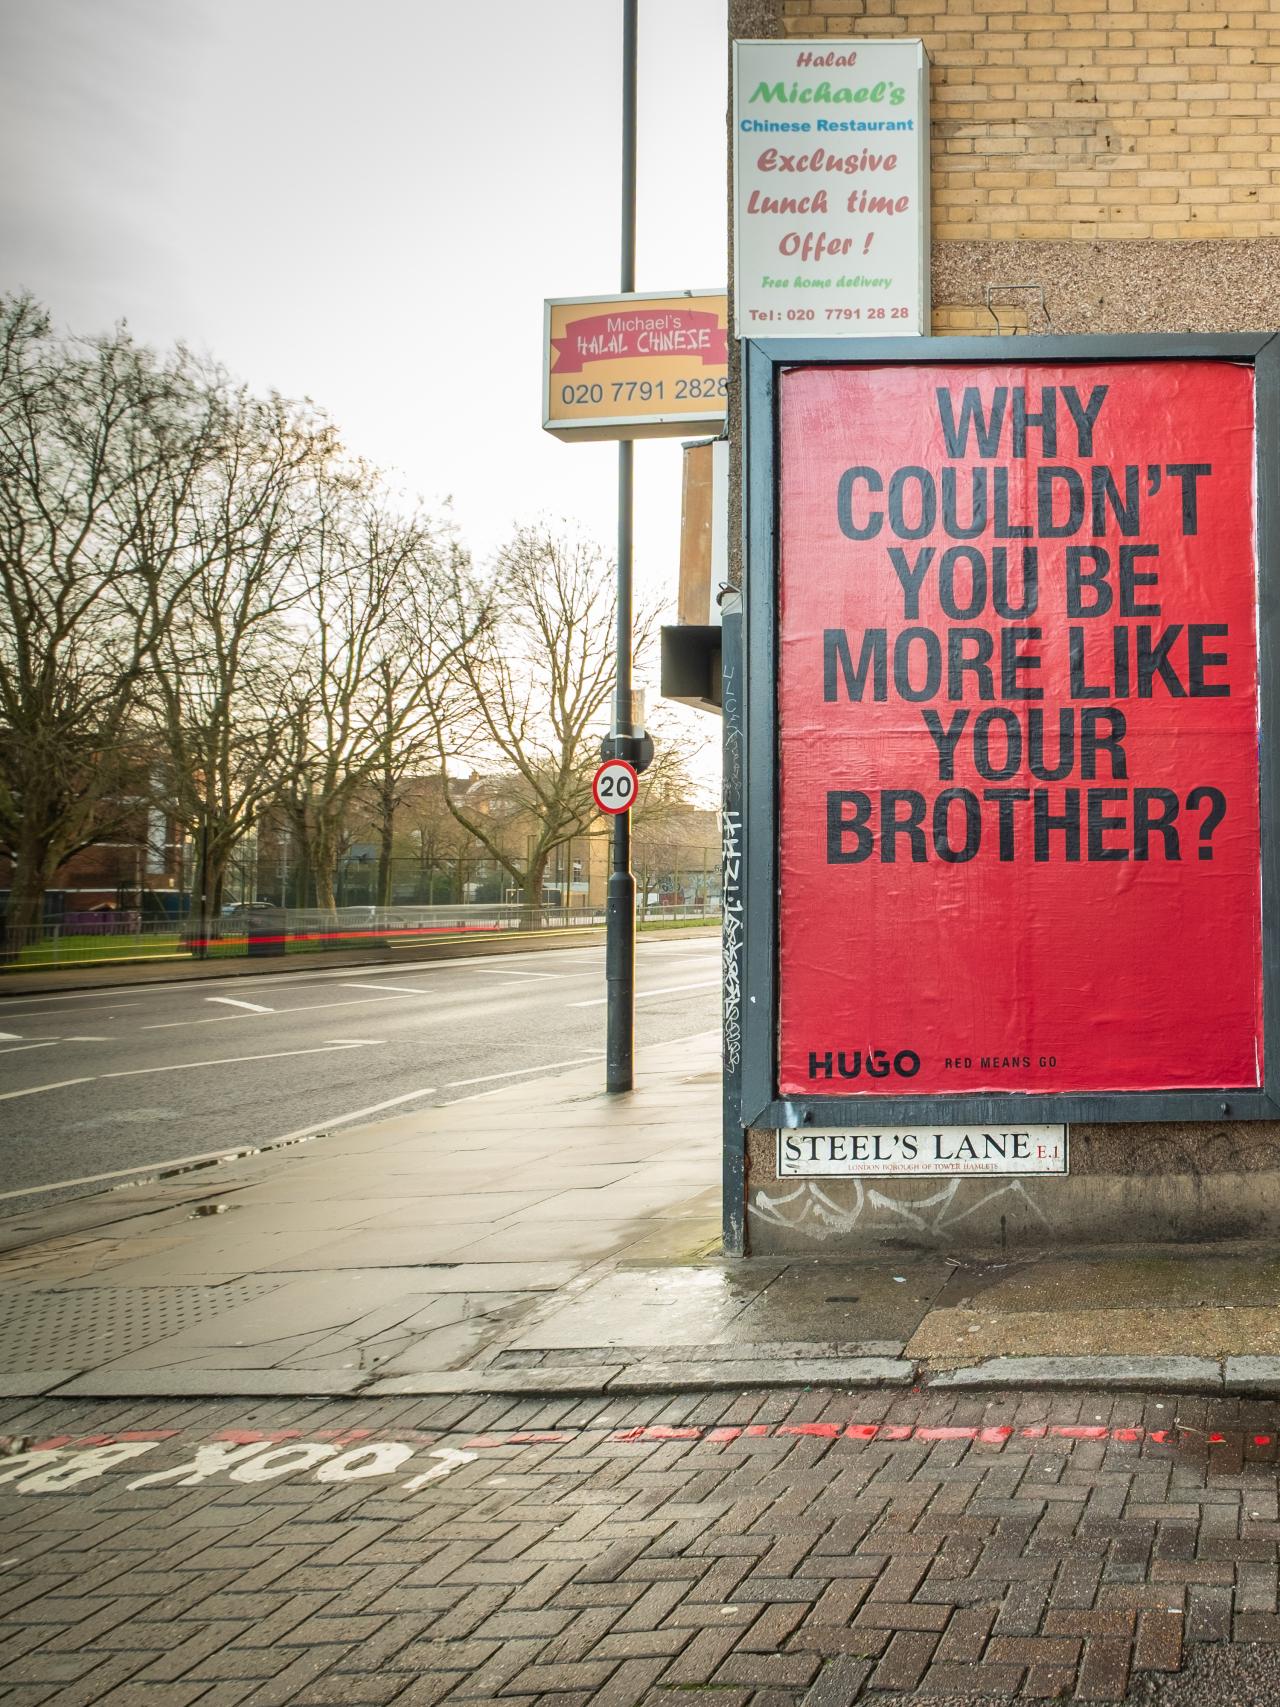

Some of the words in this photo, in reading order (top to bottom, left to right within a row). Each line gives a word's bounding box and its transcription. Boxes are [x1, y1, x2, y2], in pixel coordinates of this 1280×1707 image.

[796, 51, 857, 67] Halal
[748, 81, 905, 106] Michael's
[740, 119, 812, 132] Chinese
[816, 118, 914, 132] Restaurant
[757, 148, 898, 174] Exclusive
[747, 189, 828, 215] Lunch
[846, 189, 910, 216] time
[761, 275, 789, 288] Free
[793, 275, 832, 289] home
[836, 275, 893, 289] delivery
[607, 314, 682, 332] Michael's
[786, 308, 815, 320] 020
[824, 307, 861, 320] 7791
[867, 307, 886, 319] 28
[890, 307, 909, 319] 28
[577, 333, 628, 355] HALAL
[636, 328, 711, 352] CHINESE
[562, 383, 603, 404] 020
[611, 380, 664, 402] 7791
[675, 376, 728, 400] 2828
[936, 384, 1110, 459] WHY
[837, 463, 1212, 540] COULDN'T
[887, 546, 1038, 621] YOU
[1065, 544, 1161, 619] BE
[823, 627, 1044, 702] MORE
[1069, 623, 1231, 700] LIKE
[921, 706, 1129, 781] YOUR
[600, 776, 631, 798] 20
[826, 786, 1227, 865] BROTHER?
[808, 1049, 921, 1079] HUGO
[945, 1057, 972, 1069] RED
[981, 1056, 1031, 1068] MEANS
[1039, 1056, 1057, 1068] GO
[785, 1134, 918, 1161] STEEL'S
[932, 1133, 1031, 1160] LANE
[963, 1162, 999, 1170] HAMLETS
